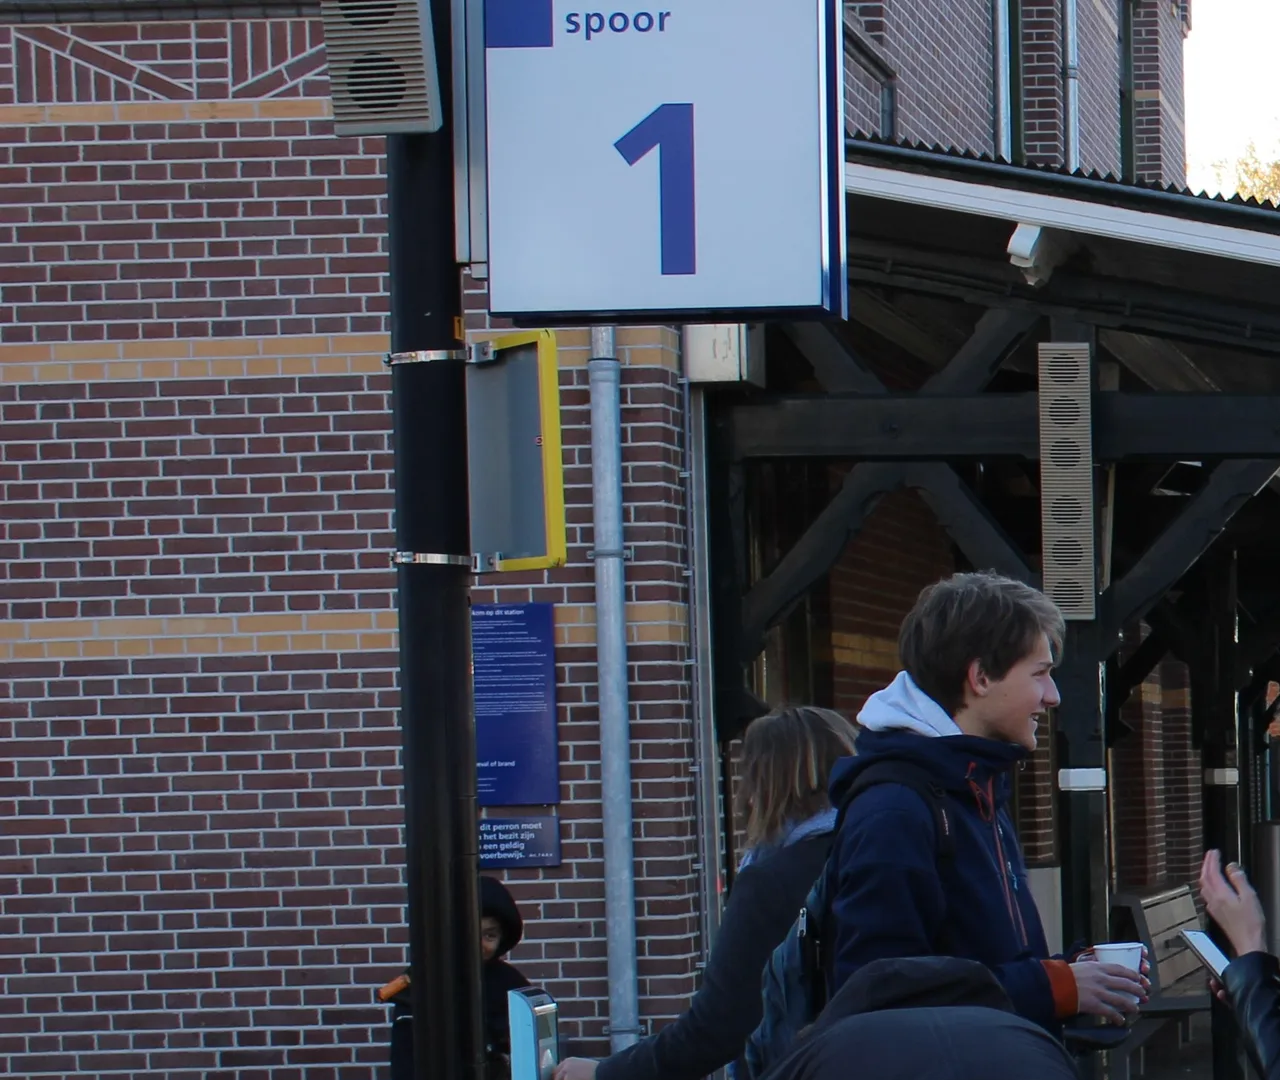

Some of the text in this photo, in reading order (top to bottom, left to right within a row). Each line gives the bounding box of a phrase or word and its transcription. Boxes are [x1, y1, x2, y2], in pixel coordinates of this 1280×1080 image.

[565, 10, 671, 41] spoor
[613, 103, 696, 275] 1
[480, 822, 542, 832] dit perron moet
[498, 832, 519, 840] bezit
[520, 831, 535, 841] zijn
[499, 842, 525, 851] geldig
